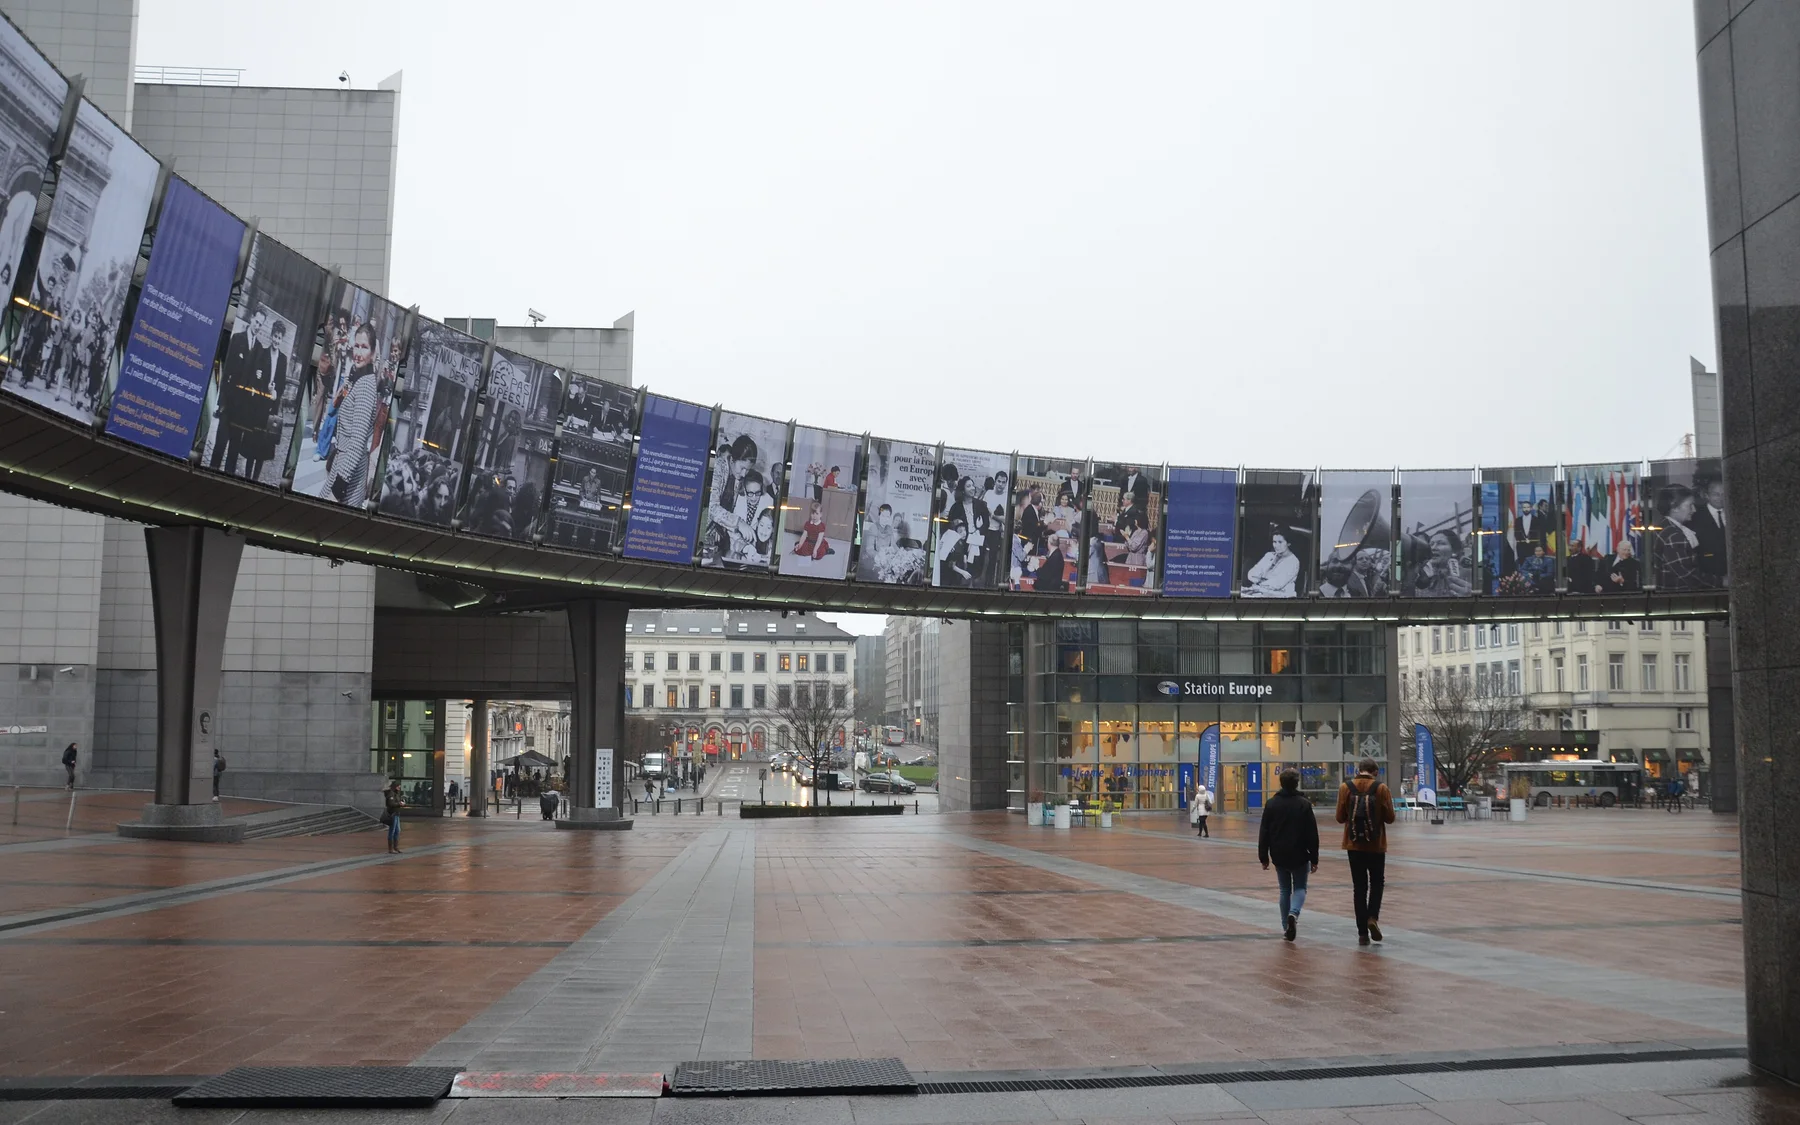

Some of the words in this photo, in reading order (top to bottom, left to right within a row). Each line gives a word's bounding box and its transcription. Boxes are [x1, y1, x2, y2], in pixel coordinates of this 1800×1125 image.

[440, 347, 457, 368] NOUS
[449, 368, 466, 384] DES
[510, 377, 530, 396] PAS
[894, 456, 912, 464] pour
[914, 456, 920, 464] la
[900, 464, 909, 472] en
[894, 480, 922, 492] Simone
[909, 475, 926, 484] avec
[1184, 682, 1224, 695] Station
[1229, 682, 1273, 698] Europe
[1208, 766, 1216, 788] STATION
